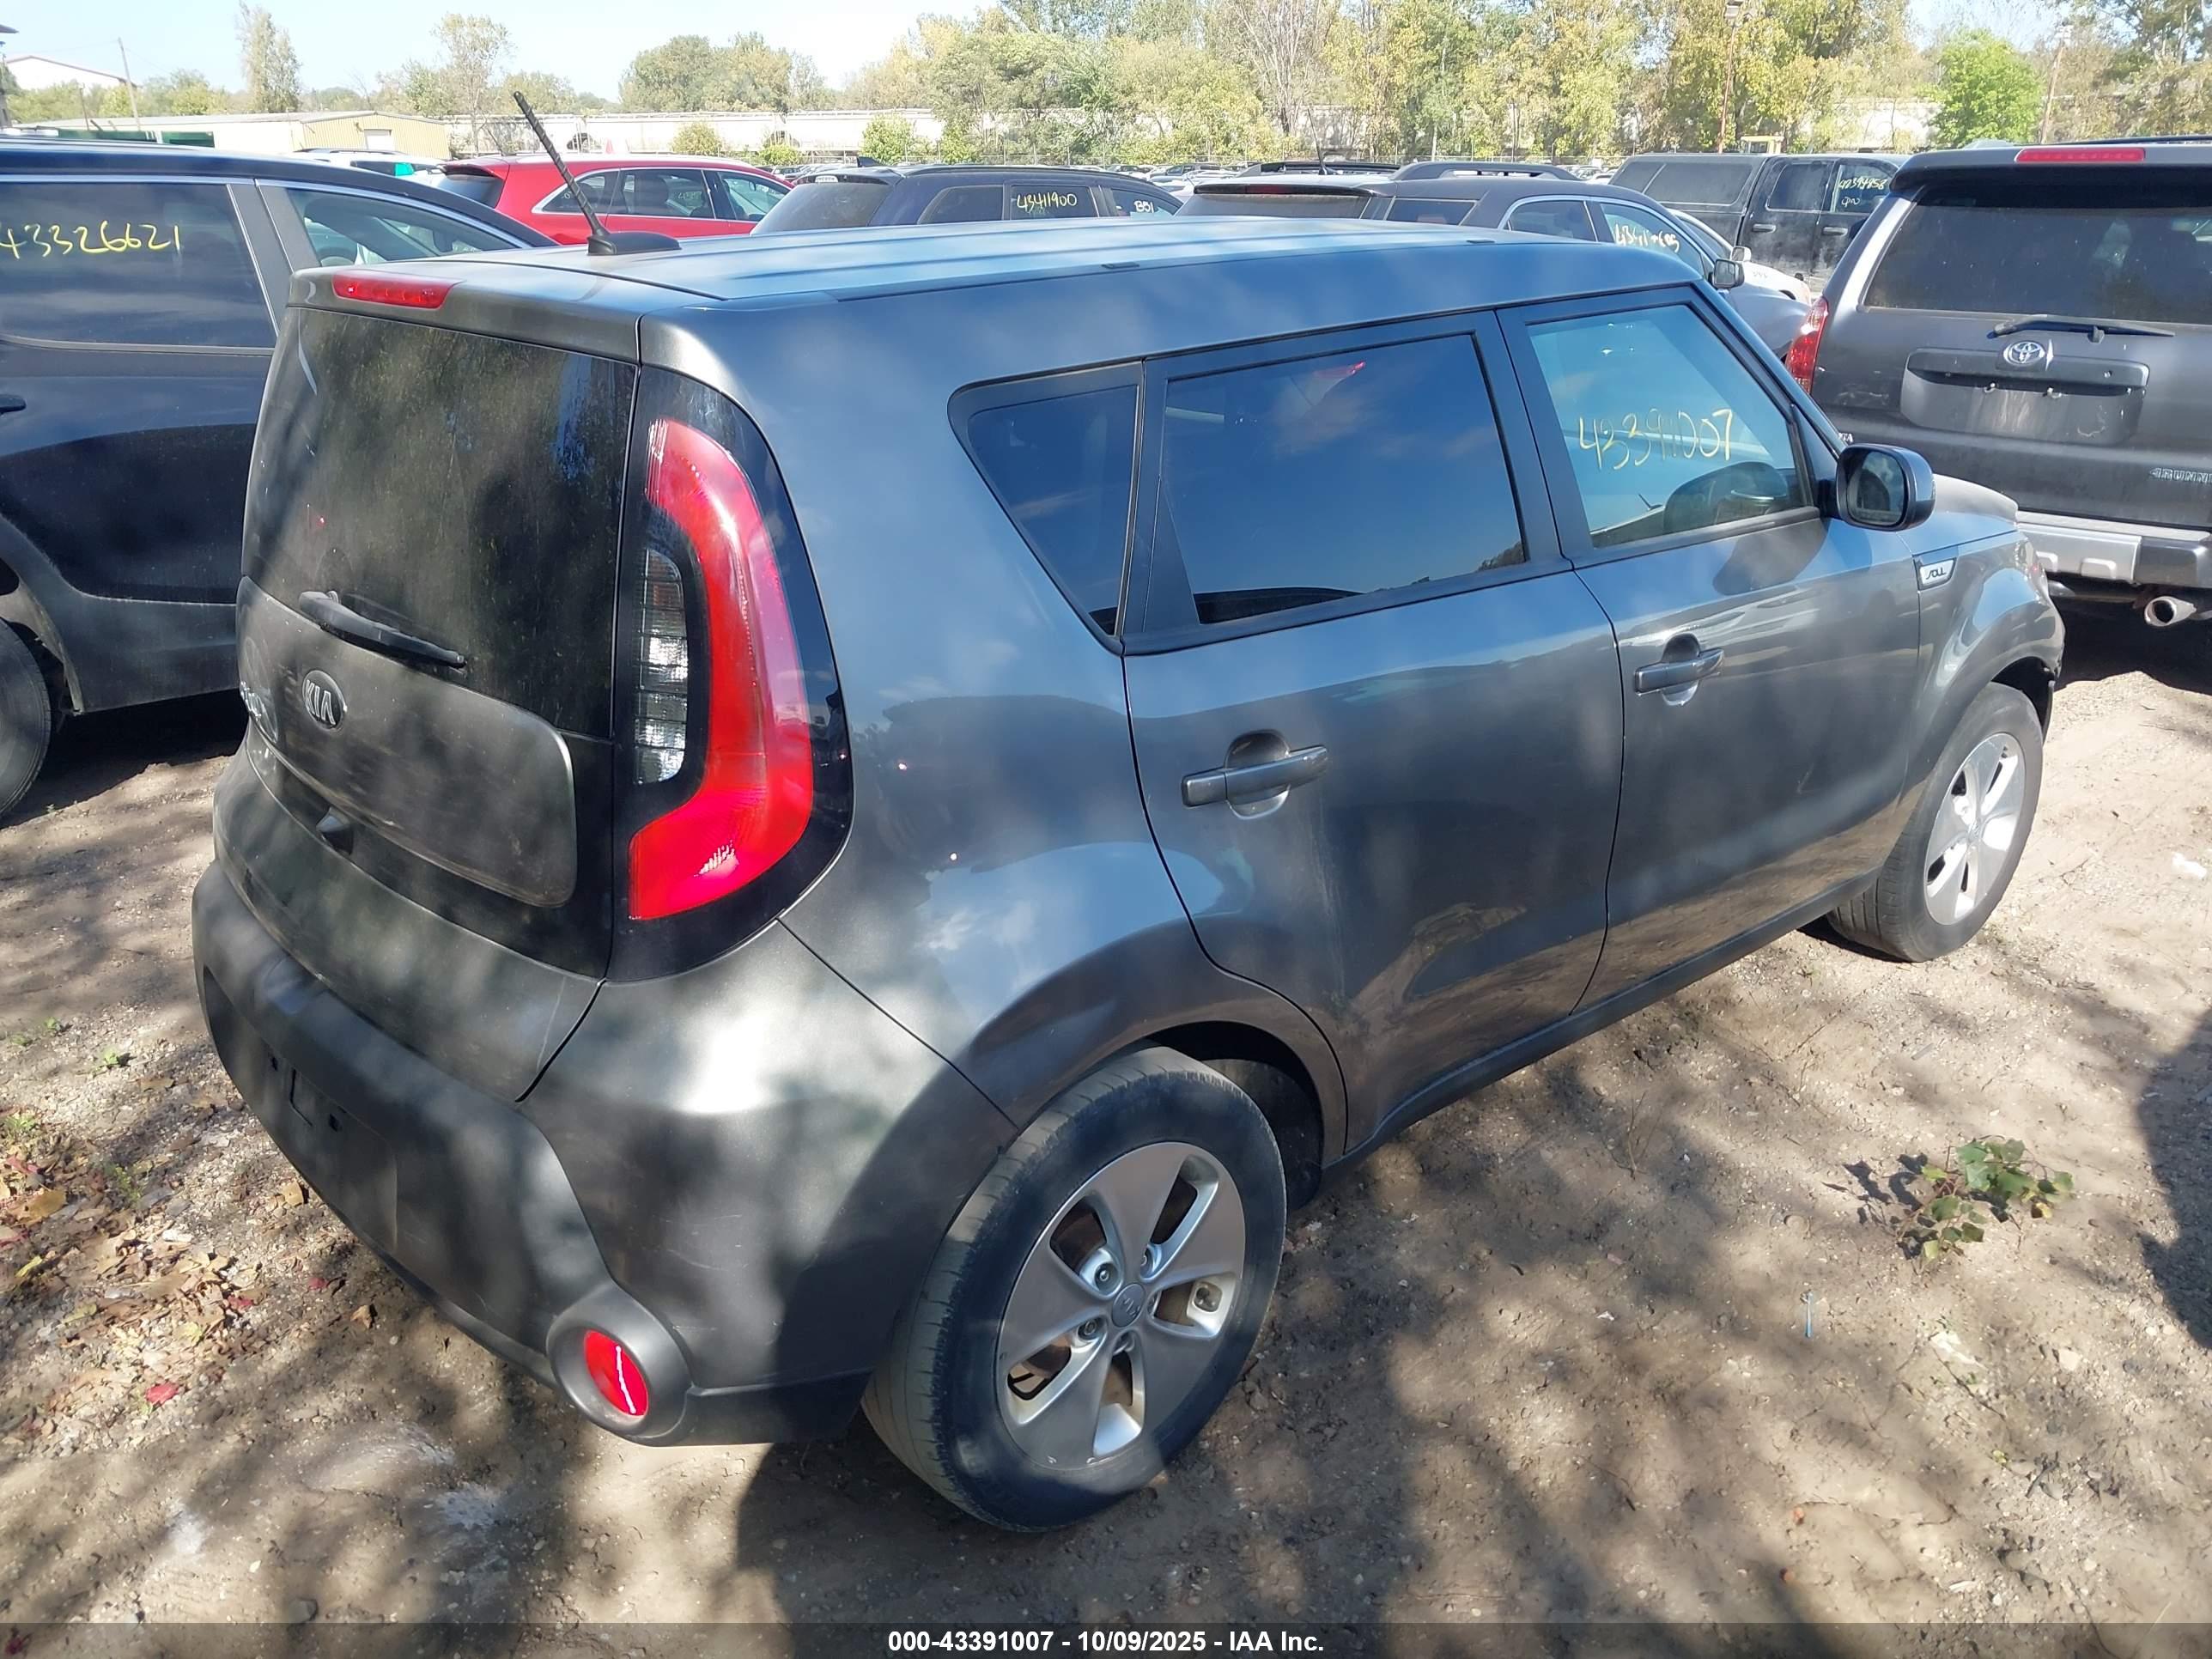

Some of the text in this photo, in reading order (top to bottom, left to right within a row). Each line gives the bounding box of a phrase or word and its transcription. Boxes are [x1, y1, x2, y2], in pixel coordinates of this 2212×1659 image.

[1017, 191, 1078, 212] 43411900
[0, 220, 181, 259] 43326621
[1579, 408, 1733, 470] 43391007
[2149, 467, 2212, 483] 4RUNN
[304, 678, 337, 726] KIA
